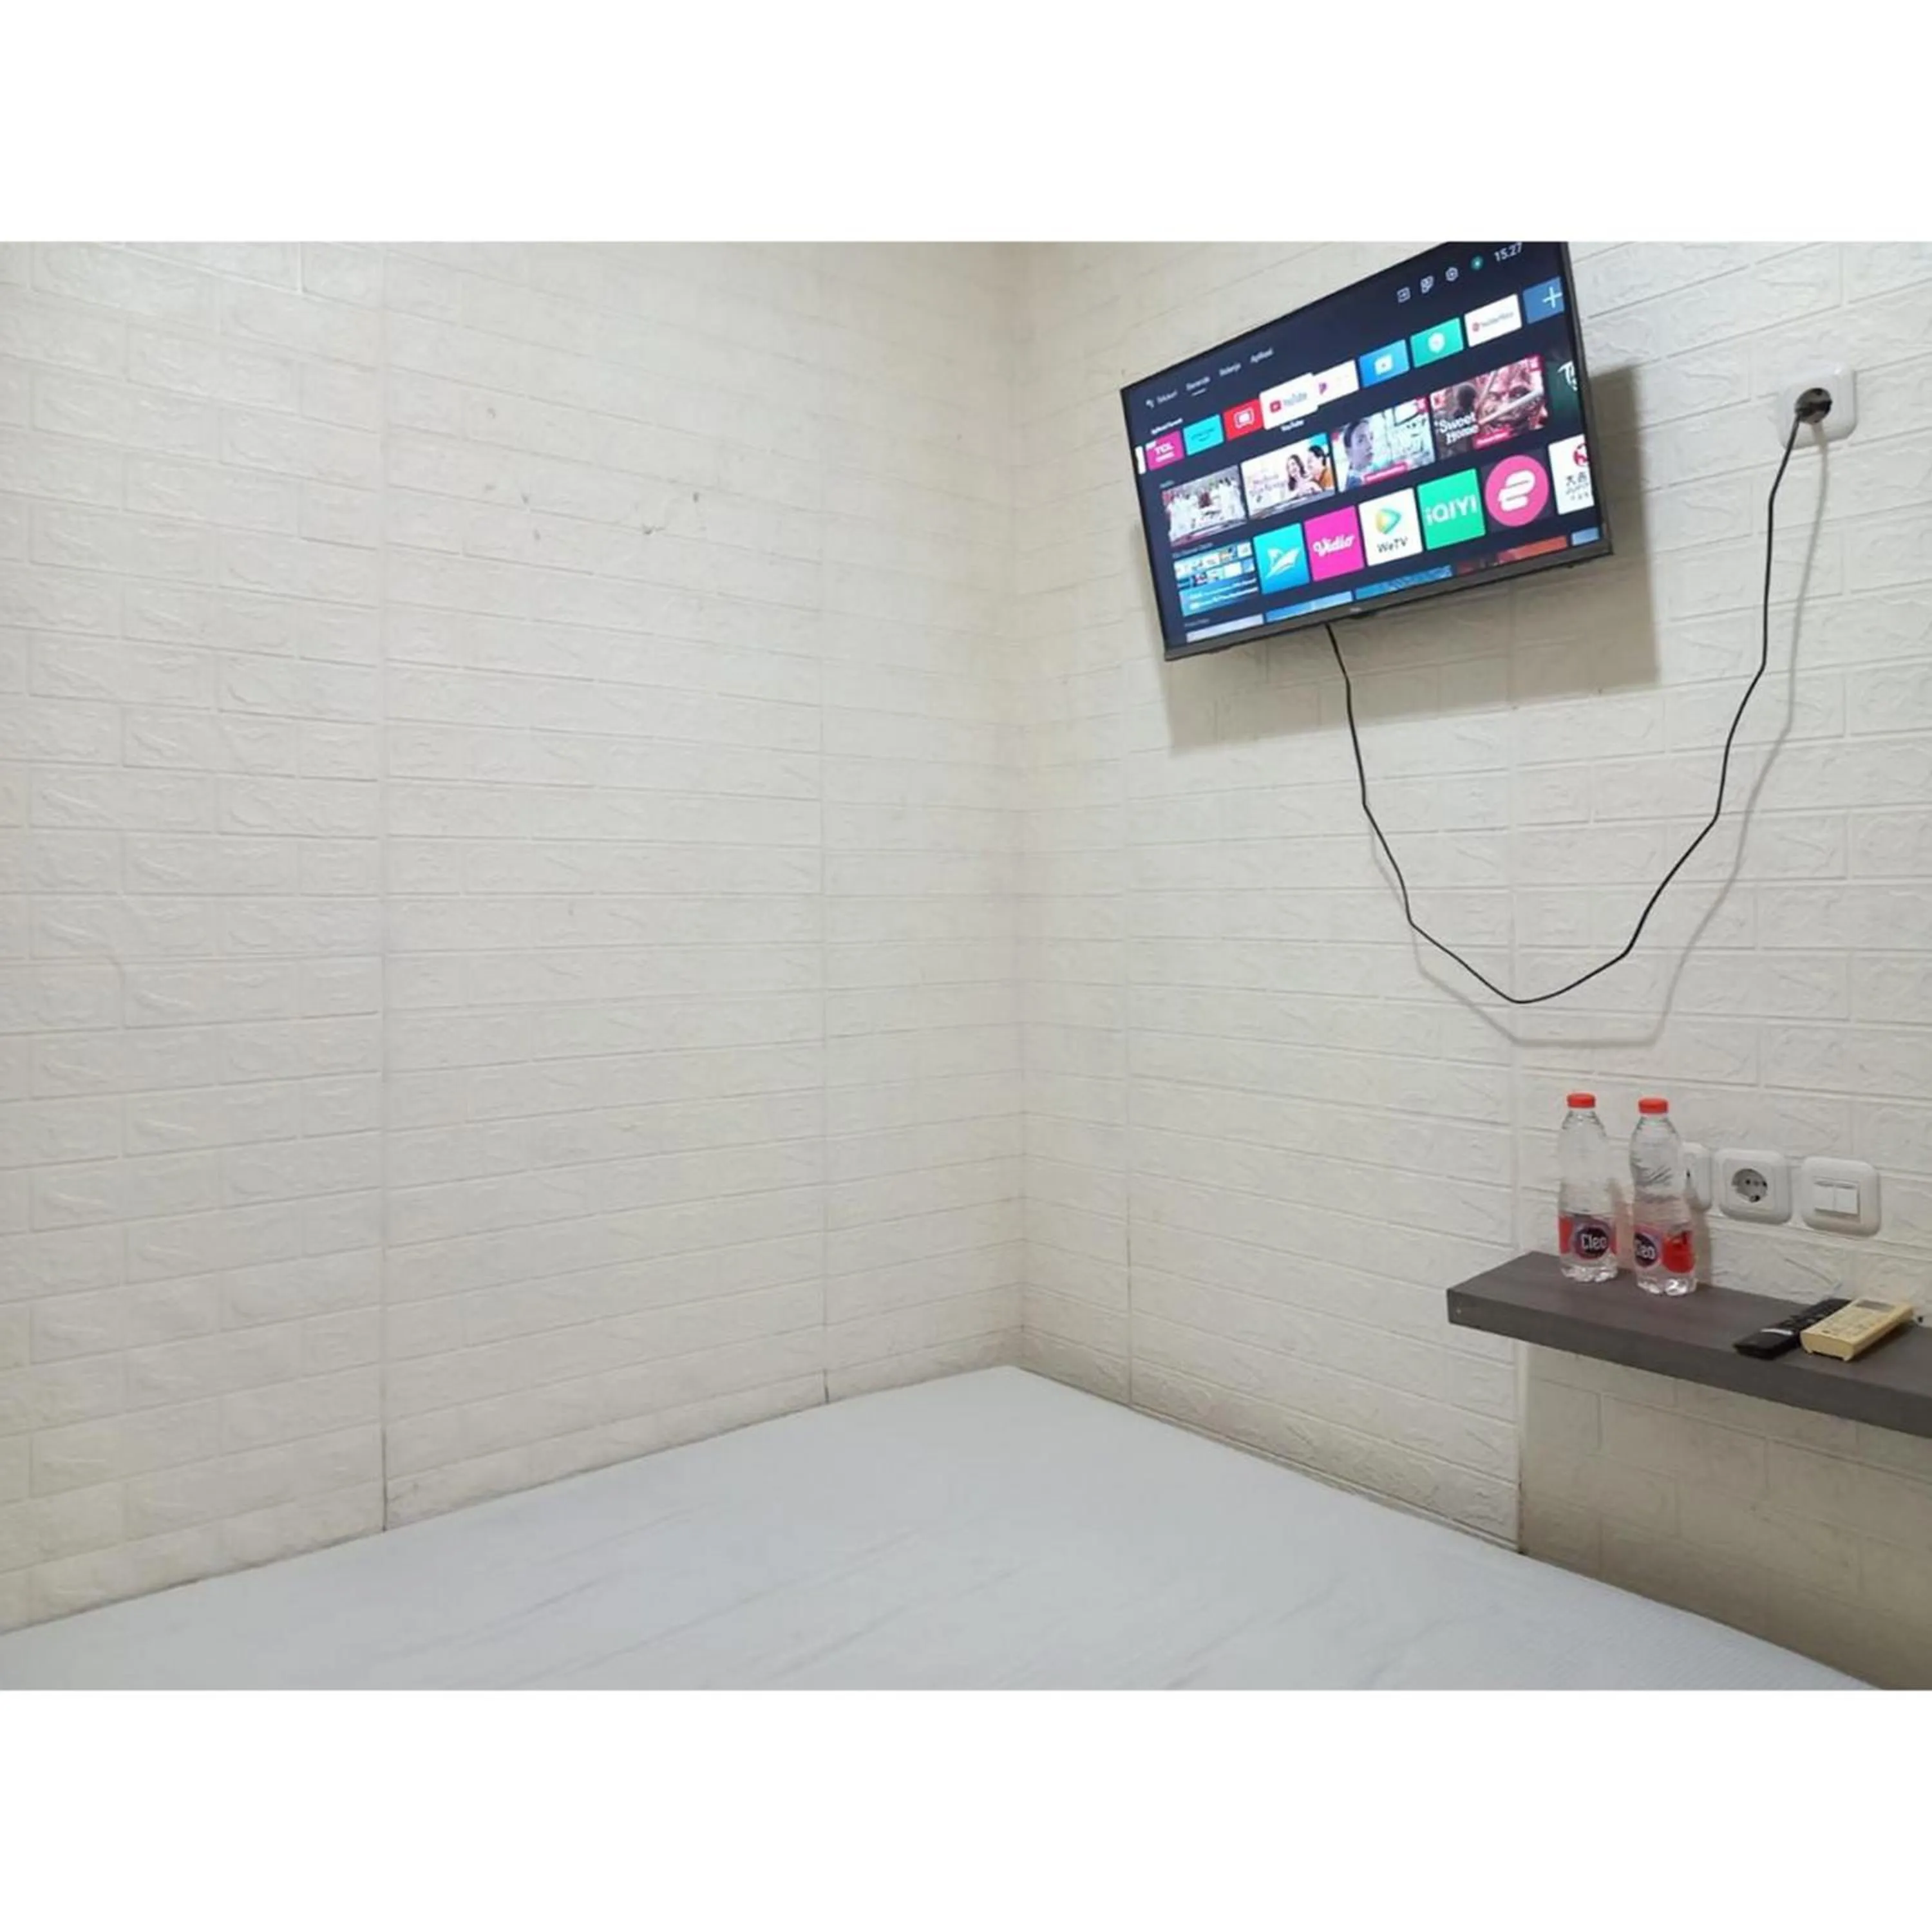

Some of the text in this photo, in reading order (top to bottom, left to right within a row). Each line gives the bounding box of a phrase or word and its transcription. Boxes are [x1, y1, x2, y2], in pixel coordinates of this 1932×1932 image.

[1439, 412, 1475, 434] Sweet
[1446, 424, 1480, 446] Home
[1312, 535, 1355, 558] Vidio
[1377, 536, 1409, 554] WeTV
[1581, 1233, 1607, 1250] Cleo
